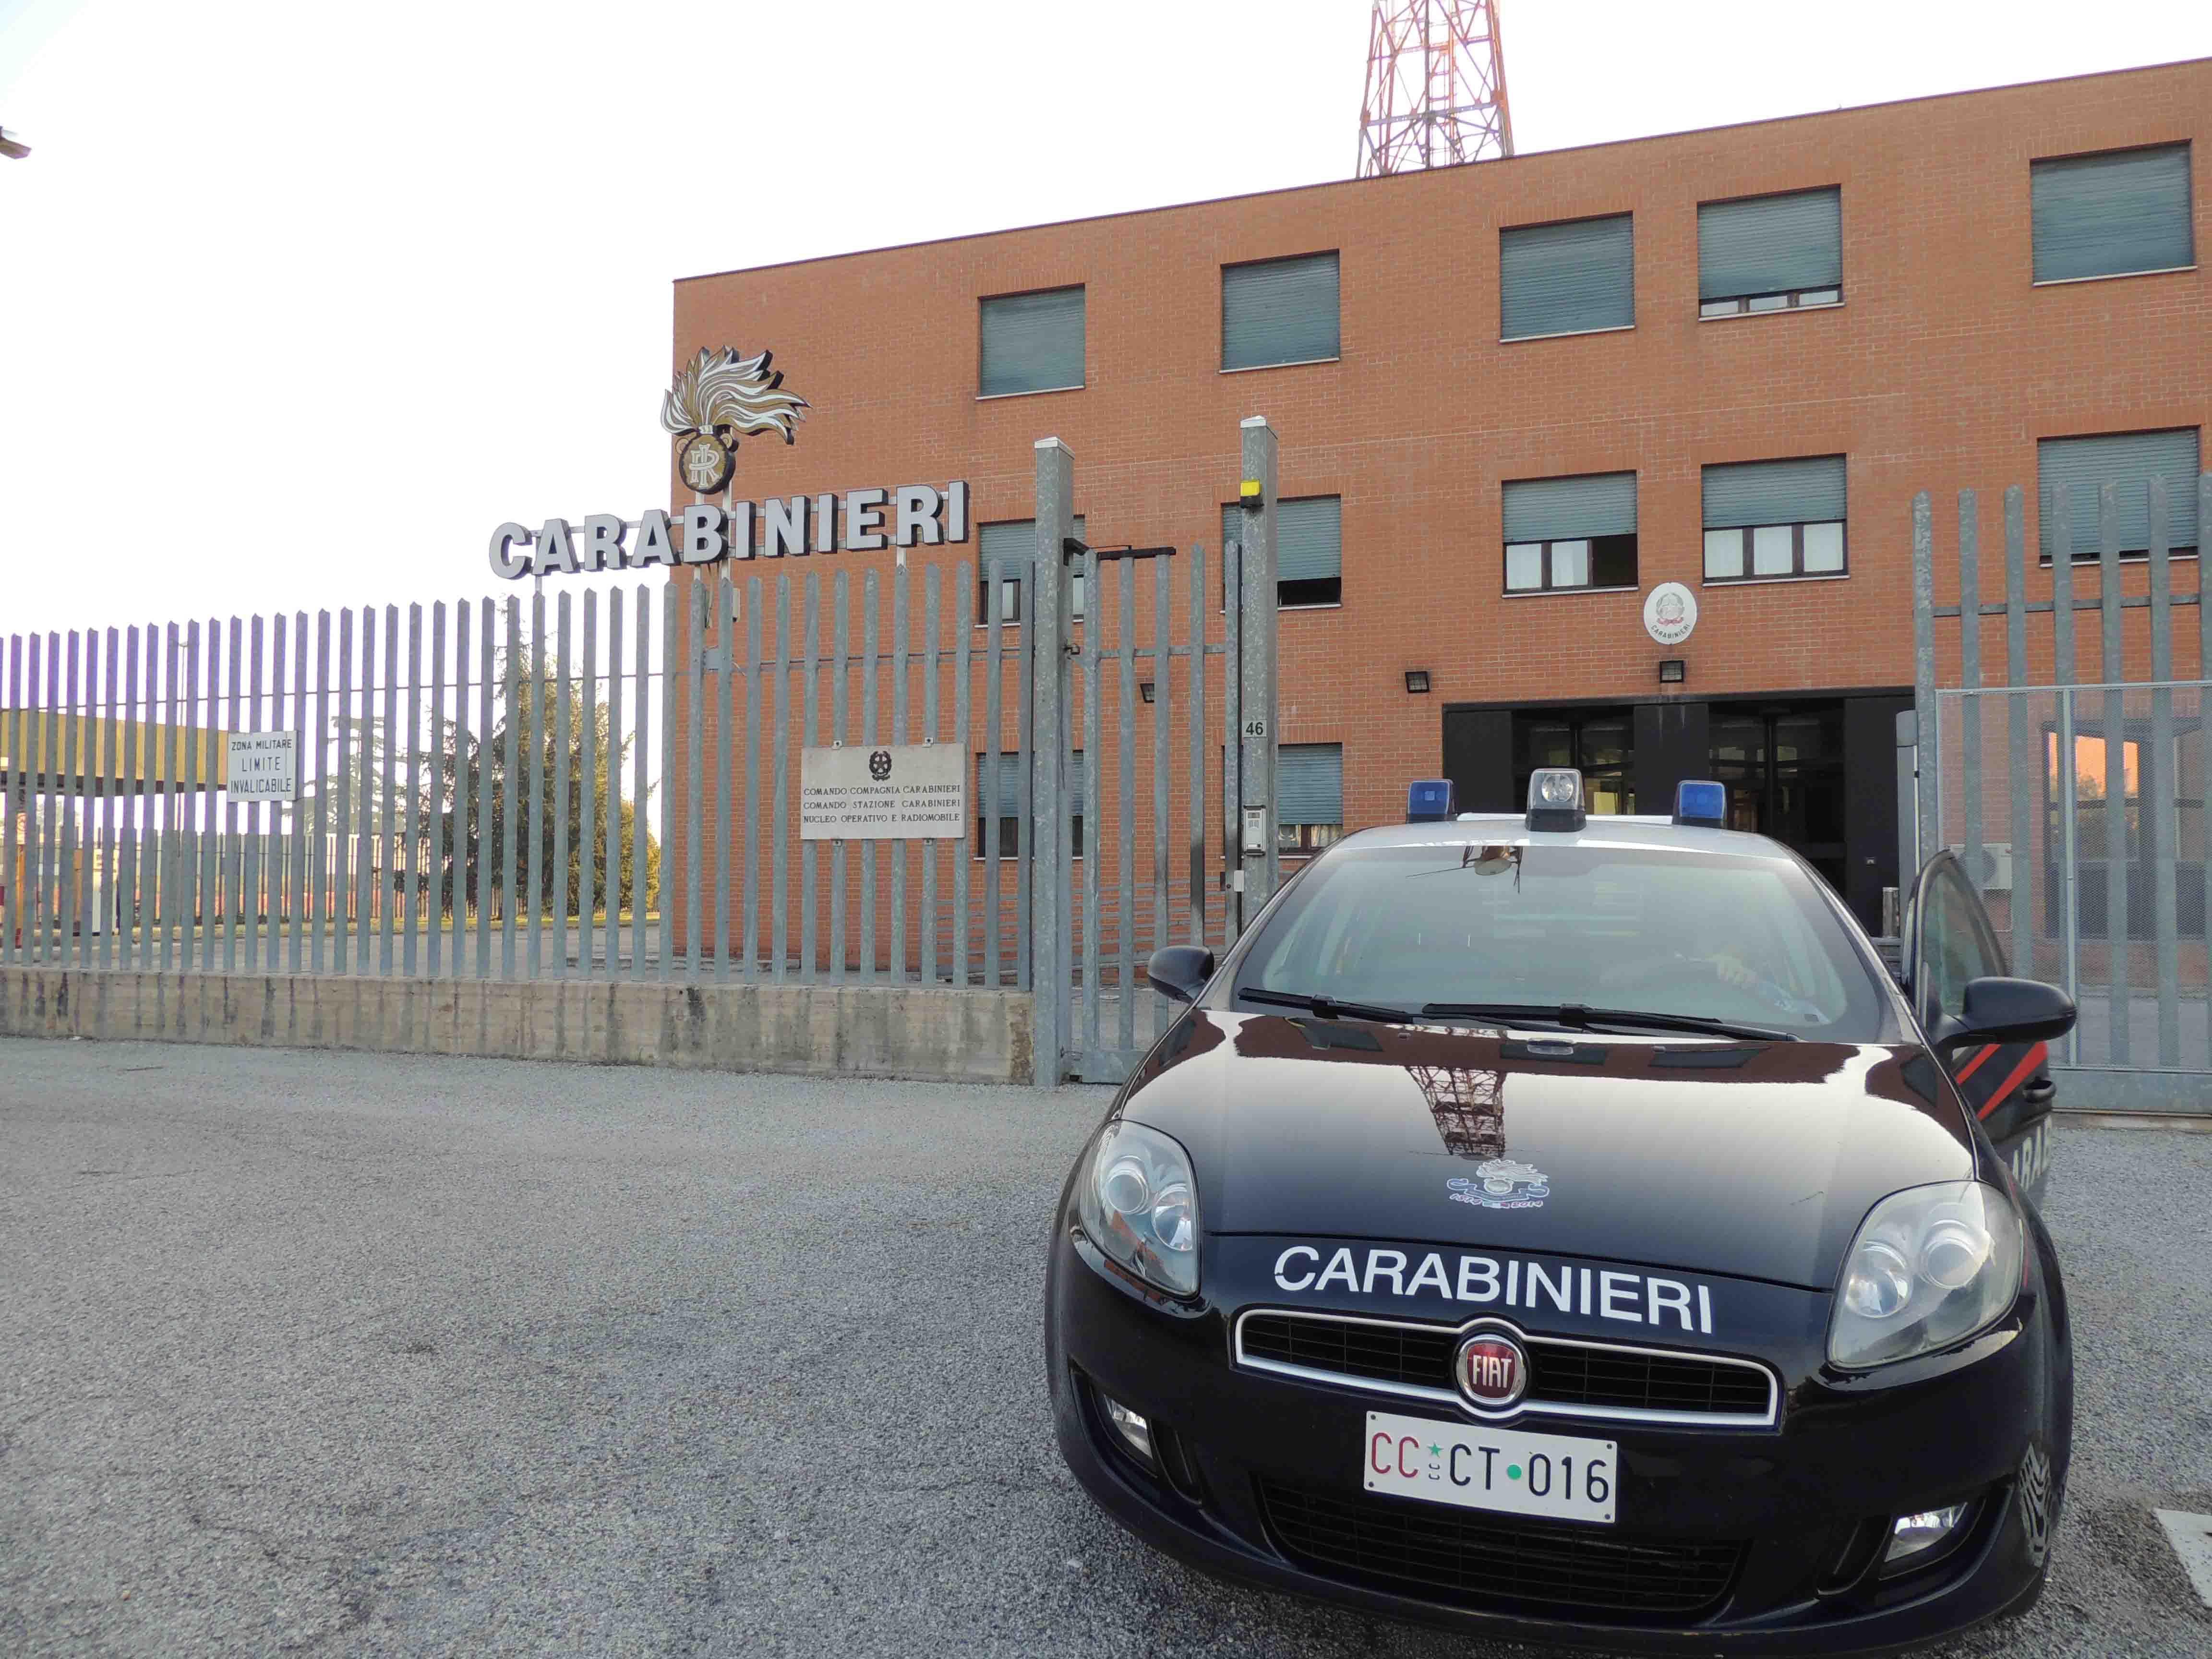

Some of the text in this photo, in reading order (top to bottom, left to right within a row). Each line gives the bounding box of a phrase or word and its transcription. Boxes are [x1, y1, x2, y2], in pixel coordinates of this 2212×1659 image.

[489, 481, 969, 580] CARABINIERI
[1651, 624, 1691, 639] CARABINIERI
[1245, 721, 1263, 735] 46
[231, 739, 292, 751] ZONA MILITARE
[241, 757, 281, 772] LIMITE
[230, 778, 292, 793] INVALICABILE
[804, 785, 961, 796] COMANDO COMPAGNIA CARABINIERI
[803, 799, 961, 810] COMANDO STAZIONE CARABINIERI
[803, 815, 837, 823] NUCLEO
[841, 814, 888, 823] OPERATIVO
[901, 813, 960, 822] RADIOMOBILE
[1274, 1245, 1712, 1334] CARABINIERI
[1472, 1354, 1512, 1388] FIAT
[1371, 1432, 1609, 1503] CC CT 016
